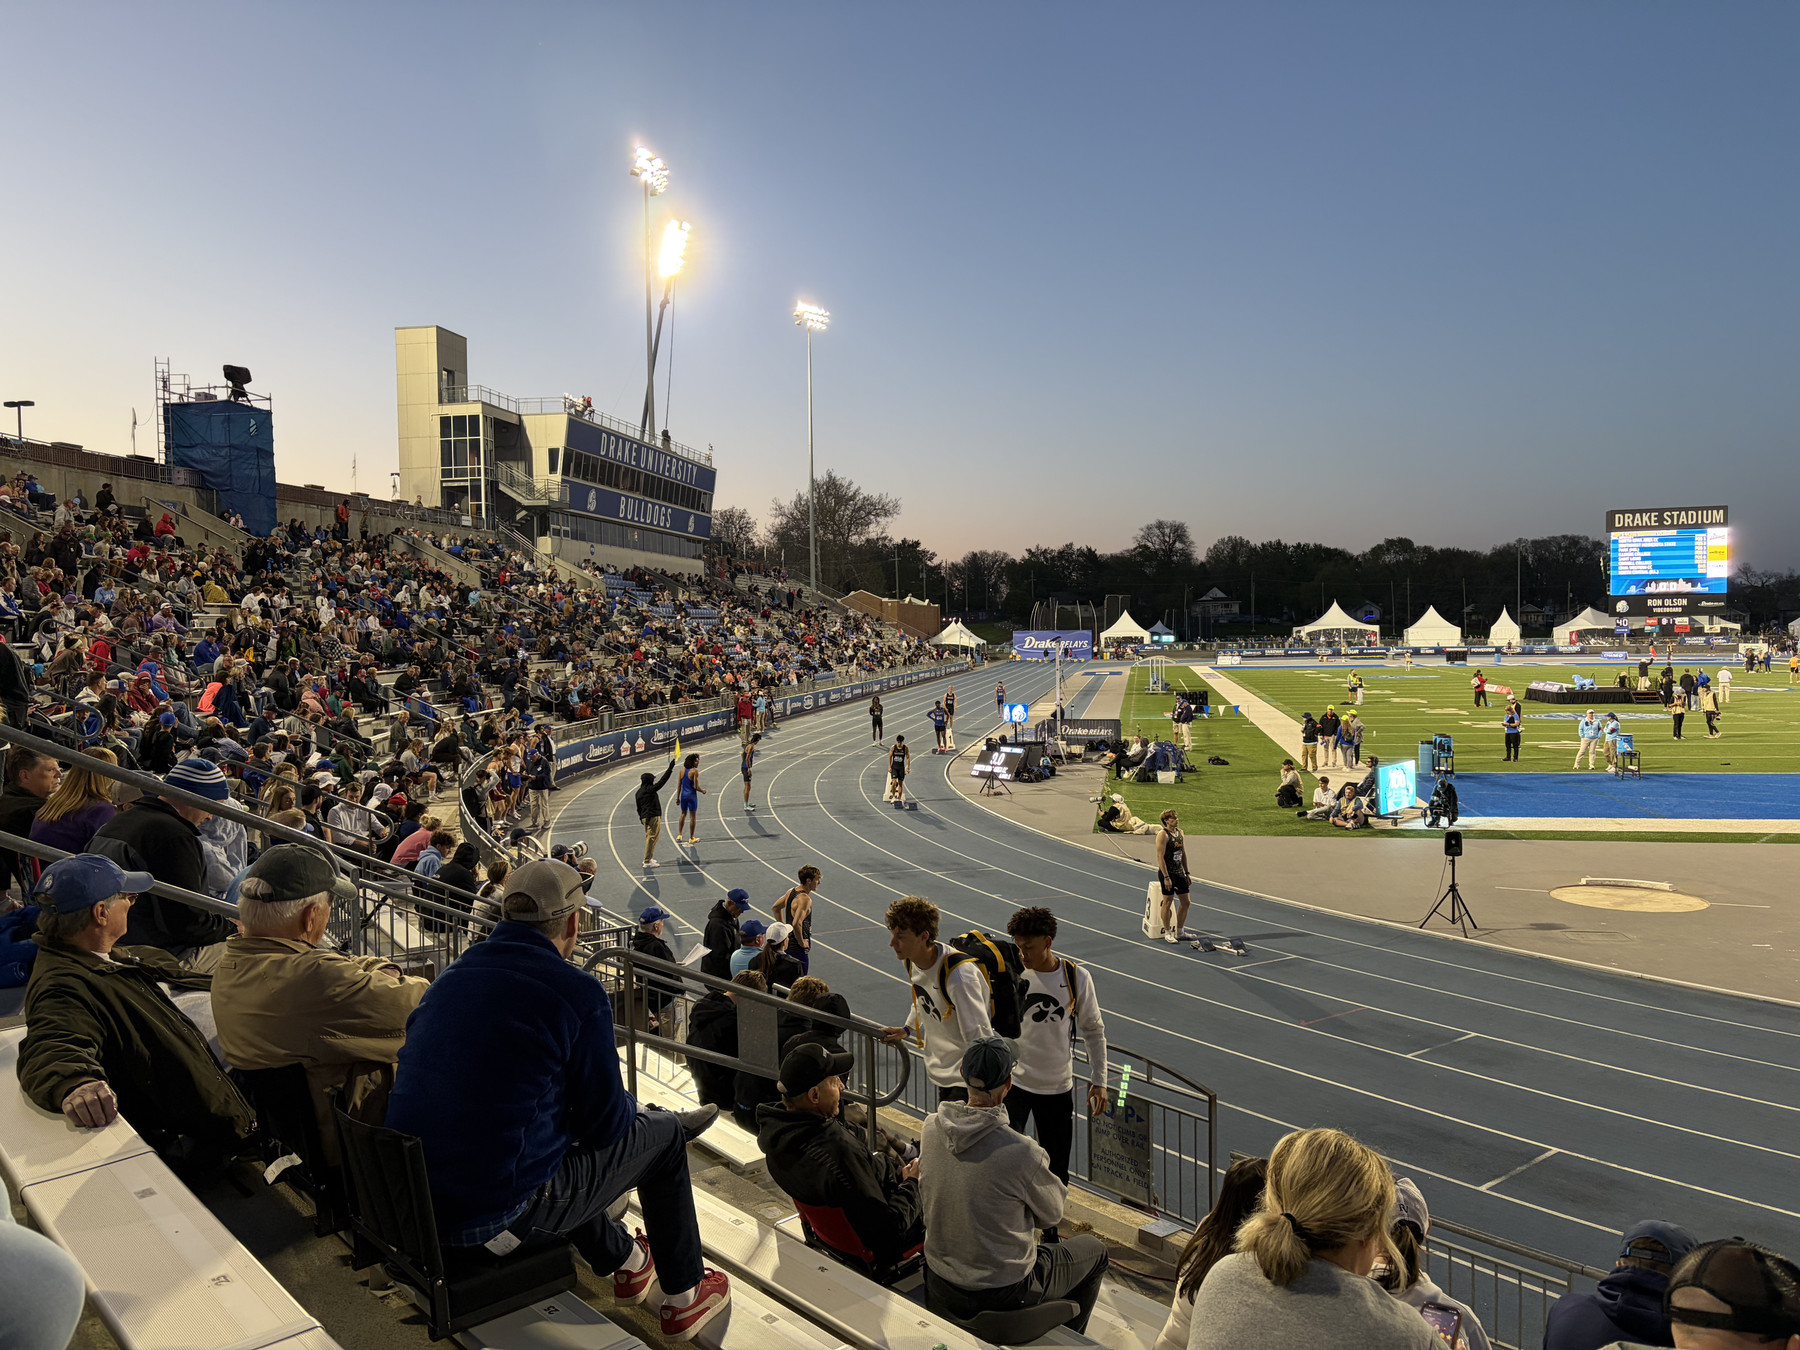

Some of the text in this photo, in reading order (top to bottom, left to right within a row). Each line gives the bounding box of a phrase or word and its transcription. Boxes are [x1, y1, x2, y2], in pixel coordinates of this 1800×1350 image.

[600, 432, 698, 485] DRAKE UNIVERSITY
[619, 496, 672, 528] BULLDOGS
[1614, 509, 1724, 527] DRAKE STADIUM
[1647, 598, 1688, 607] RON OLSON
[1616, 618, 1628, 627] 40
[1023, 636, 1088, 649] Drake RELAYS
[1061, 725, 1088, 735] Drake
[1146, 897, 1151, 920] 3
[1125, 1104, 1136, 1124] P
[1095, 1127, 1145, 1150] JUMP OVER RAIL
[1117, 1126, 1136, 1138] CLIMB
[1094, 1153, 1147, 1178] PERSONNEL ONLY
[1101, 1148, 1138, 1167] AUTHORIZED
[1103, 1167, 1123, 1180] TRACK
[1125, 1175, 1131, 1183] &
[1133, 1178, 1149, 1189] FIELD
[211, 1275, 231, 1287] 25
[543, 1305, 560, 1315] 25
